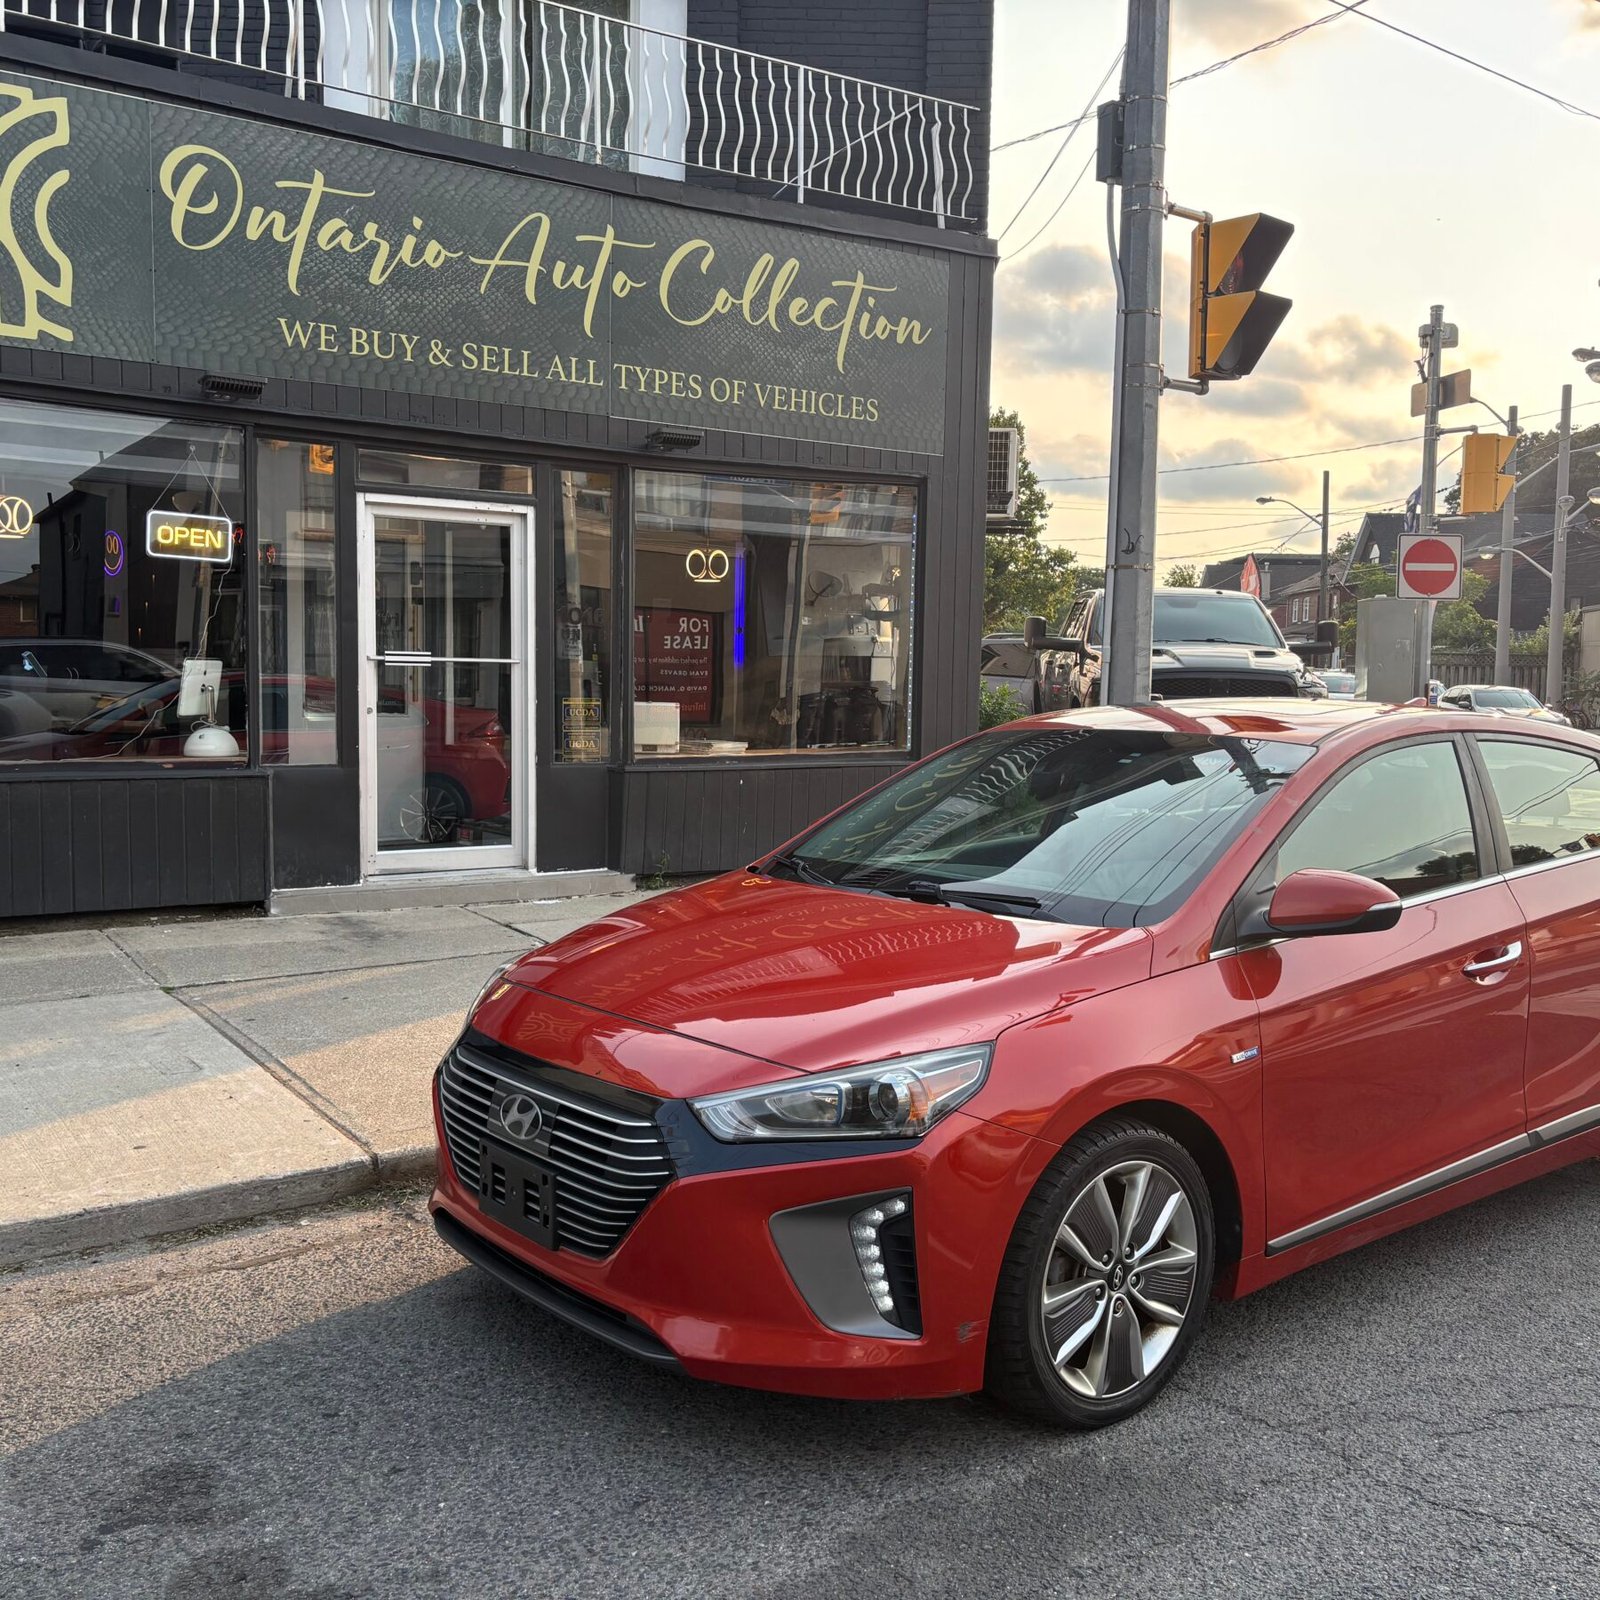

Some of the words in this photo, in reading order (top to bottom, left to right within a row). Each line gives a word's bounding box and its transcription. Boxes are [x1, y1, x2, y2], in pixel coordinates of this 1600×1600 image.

[160, 144, 463, 296] Ontario
[468, 212, 656, 338] Auto
[659, 239, 933, 374] Collection
[276, 317, 340, 352] WE
[349, 327, 421, 363] BUY
[428, 341, 454, 367] &
[461, 342, 539, 378] SELL
[545, 355, 605, 387] ALL
[613, 363, 702, 399] TYPES
[709, 377, 746, 407] OF
[753, 382, 880, 422] VEHICLES
[157, 525, 222, 548] OPEN
[569, 708, 595, 717] UCDA
[568, 740, 596, 748] UCDA
